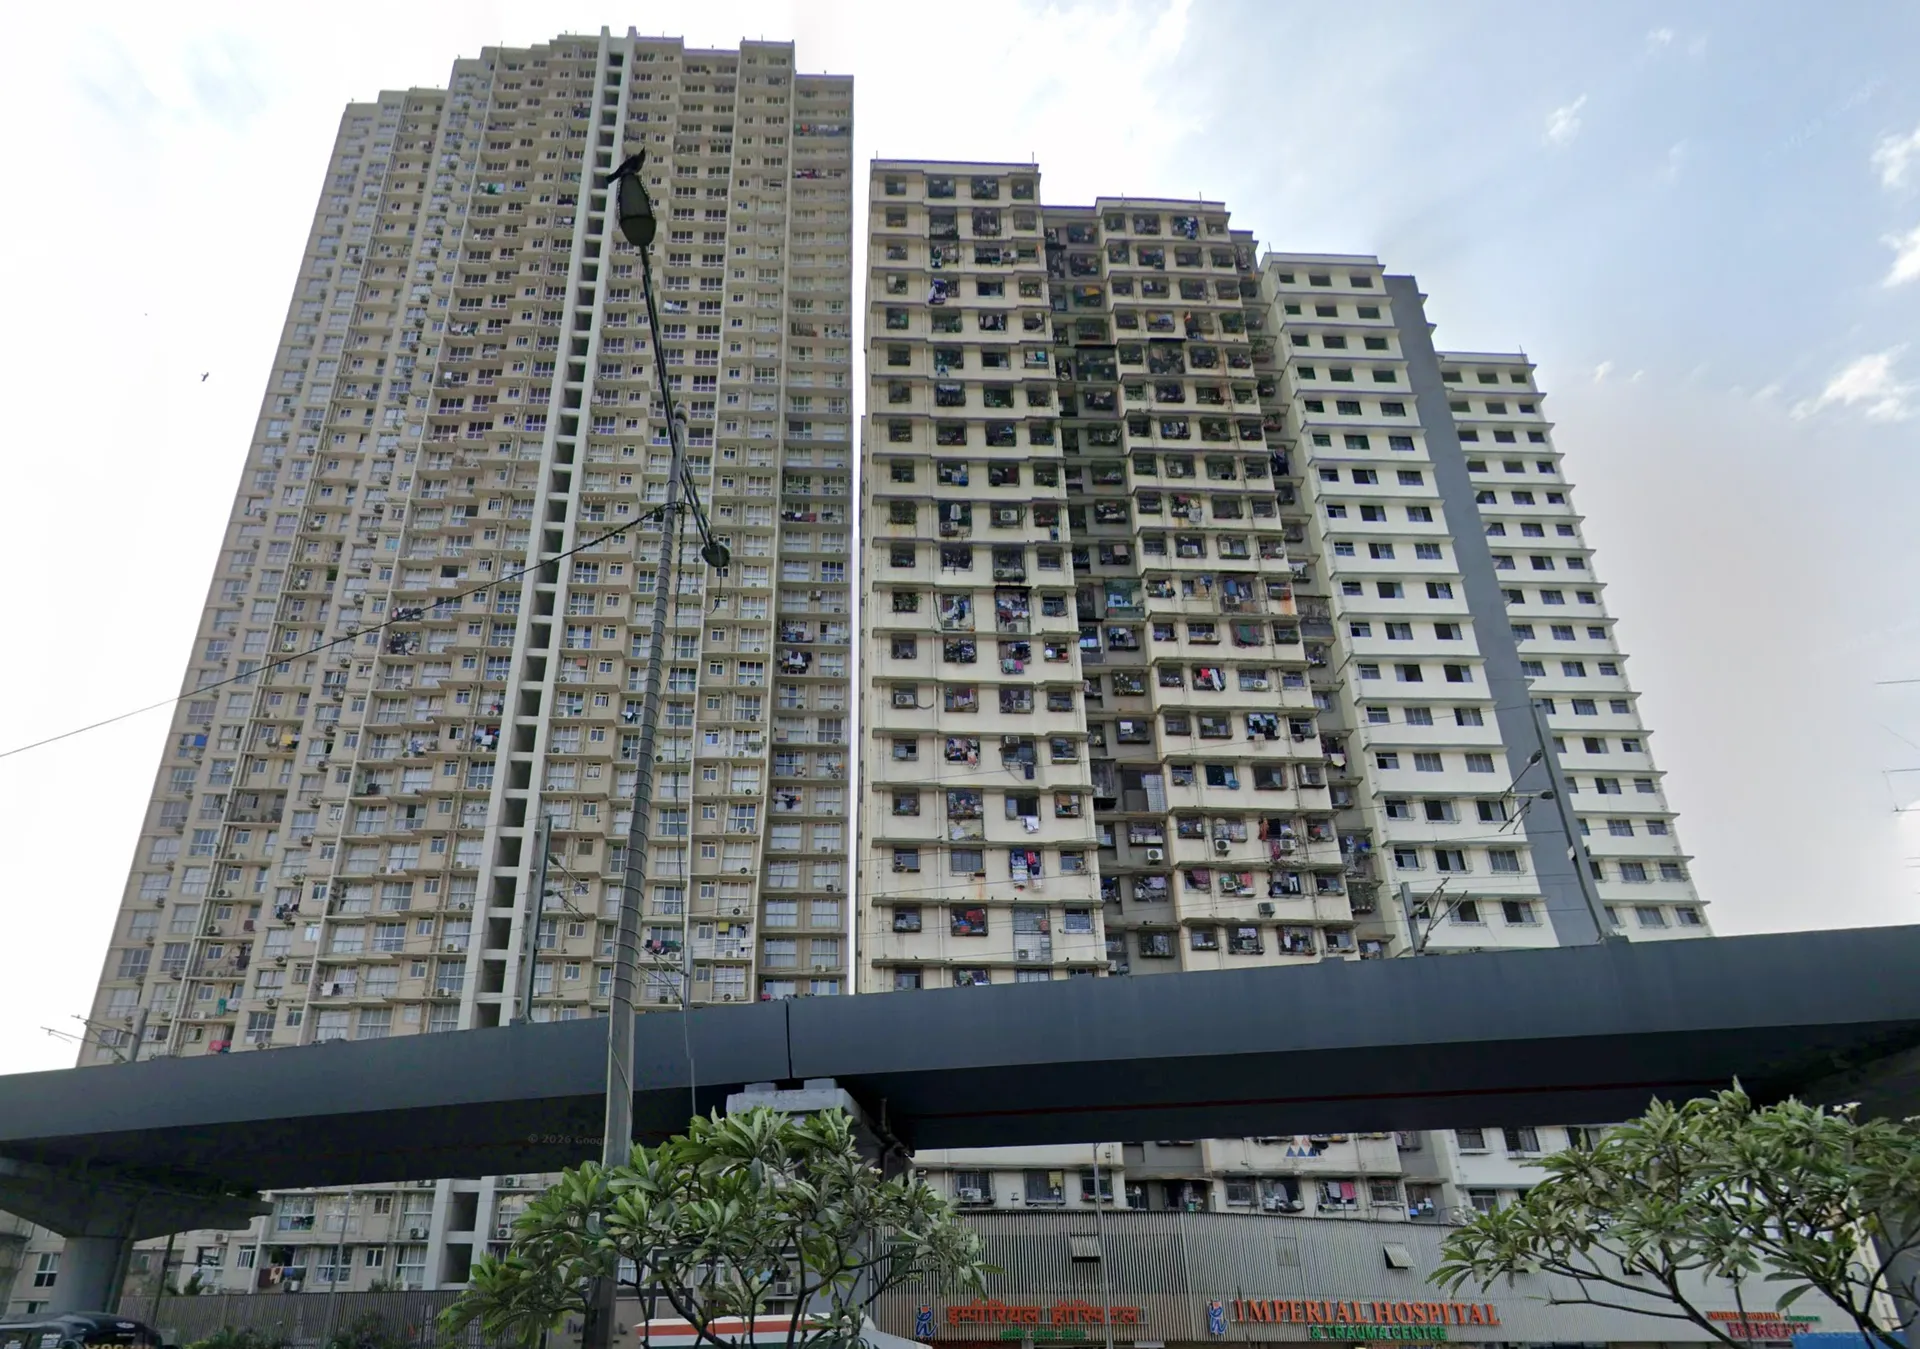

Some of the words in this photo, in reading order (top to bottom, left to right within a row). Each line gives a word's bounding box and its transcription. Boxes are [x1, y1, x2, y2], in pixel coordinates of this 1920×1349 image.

[1235, 1299, 1368, 1323] IMPERIAL
[1372, 1301, 1502, 1325] HOSPITAL
[1310, 1325, 1321, 1339] &
[1325, 1325, 1389, 1340] TRAUMA
[1391, 1325, 1449, 1340] CENTRE
[1726, 1322, 1812, 1339] EMERGENCY
